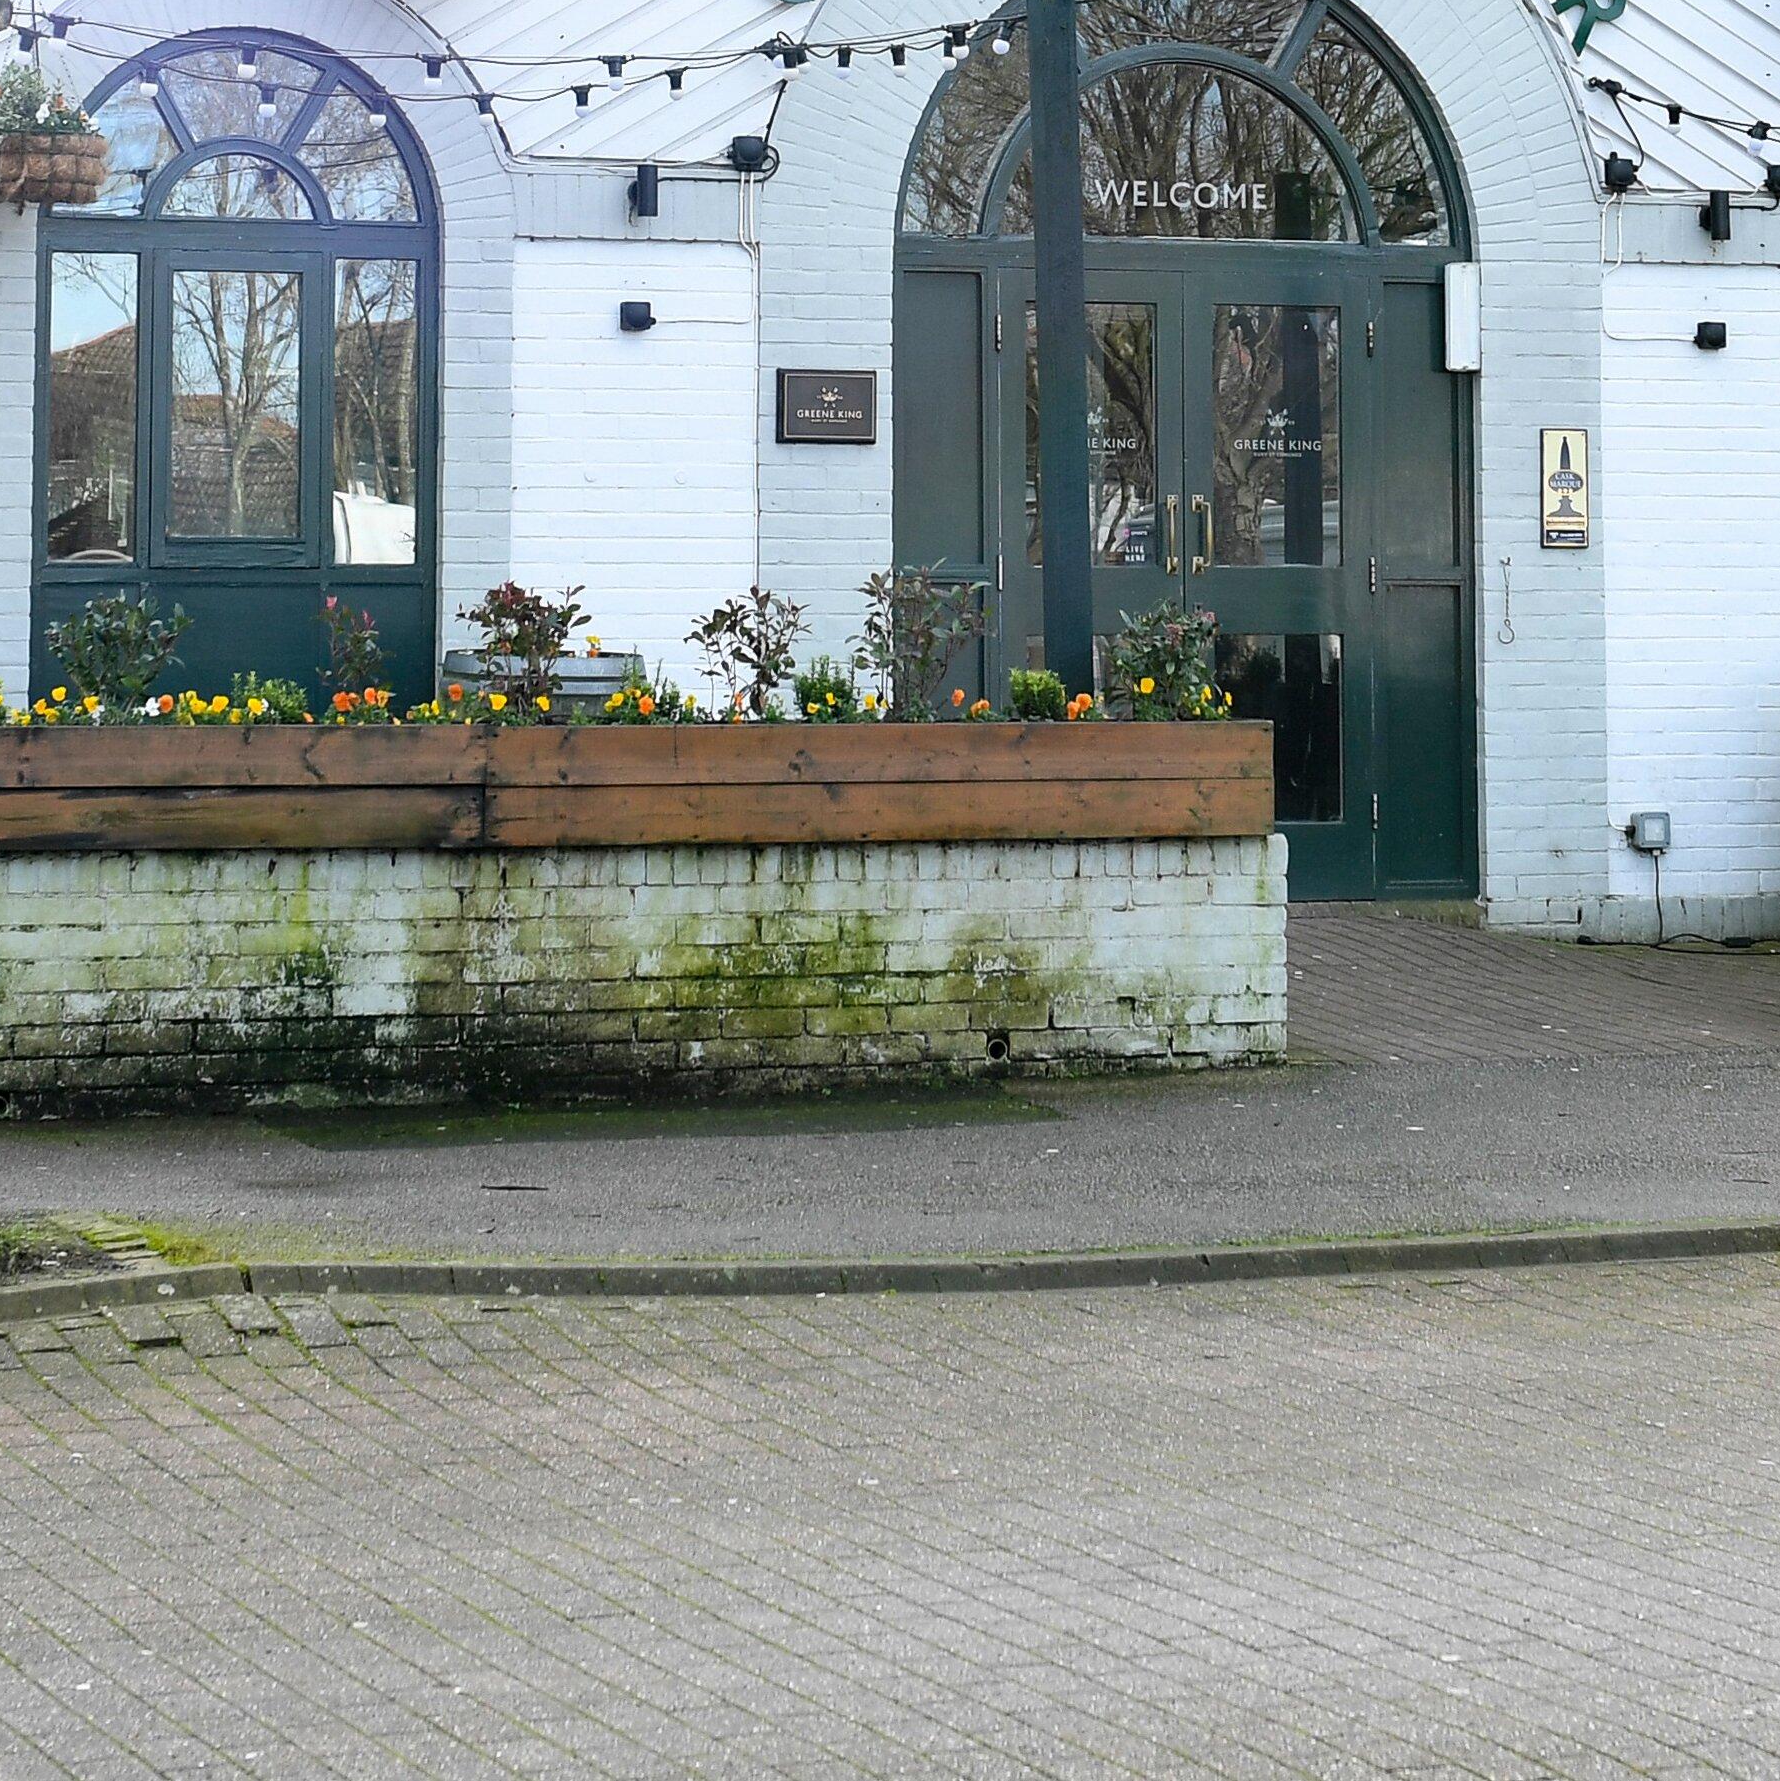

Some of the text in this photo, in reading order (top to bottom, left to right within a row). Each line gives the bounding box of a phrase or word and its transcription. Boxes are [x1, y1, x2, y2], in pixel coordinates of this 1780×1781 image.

[1094, 178, 1268, 210] WELCOME
[796, 409, 863, 419] GREENE KING
[1102, 437, 1137, 449] KING
[1233, 439, 1322, 451] GREENE KING
